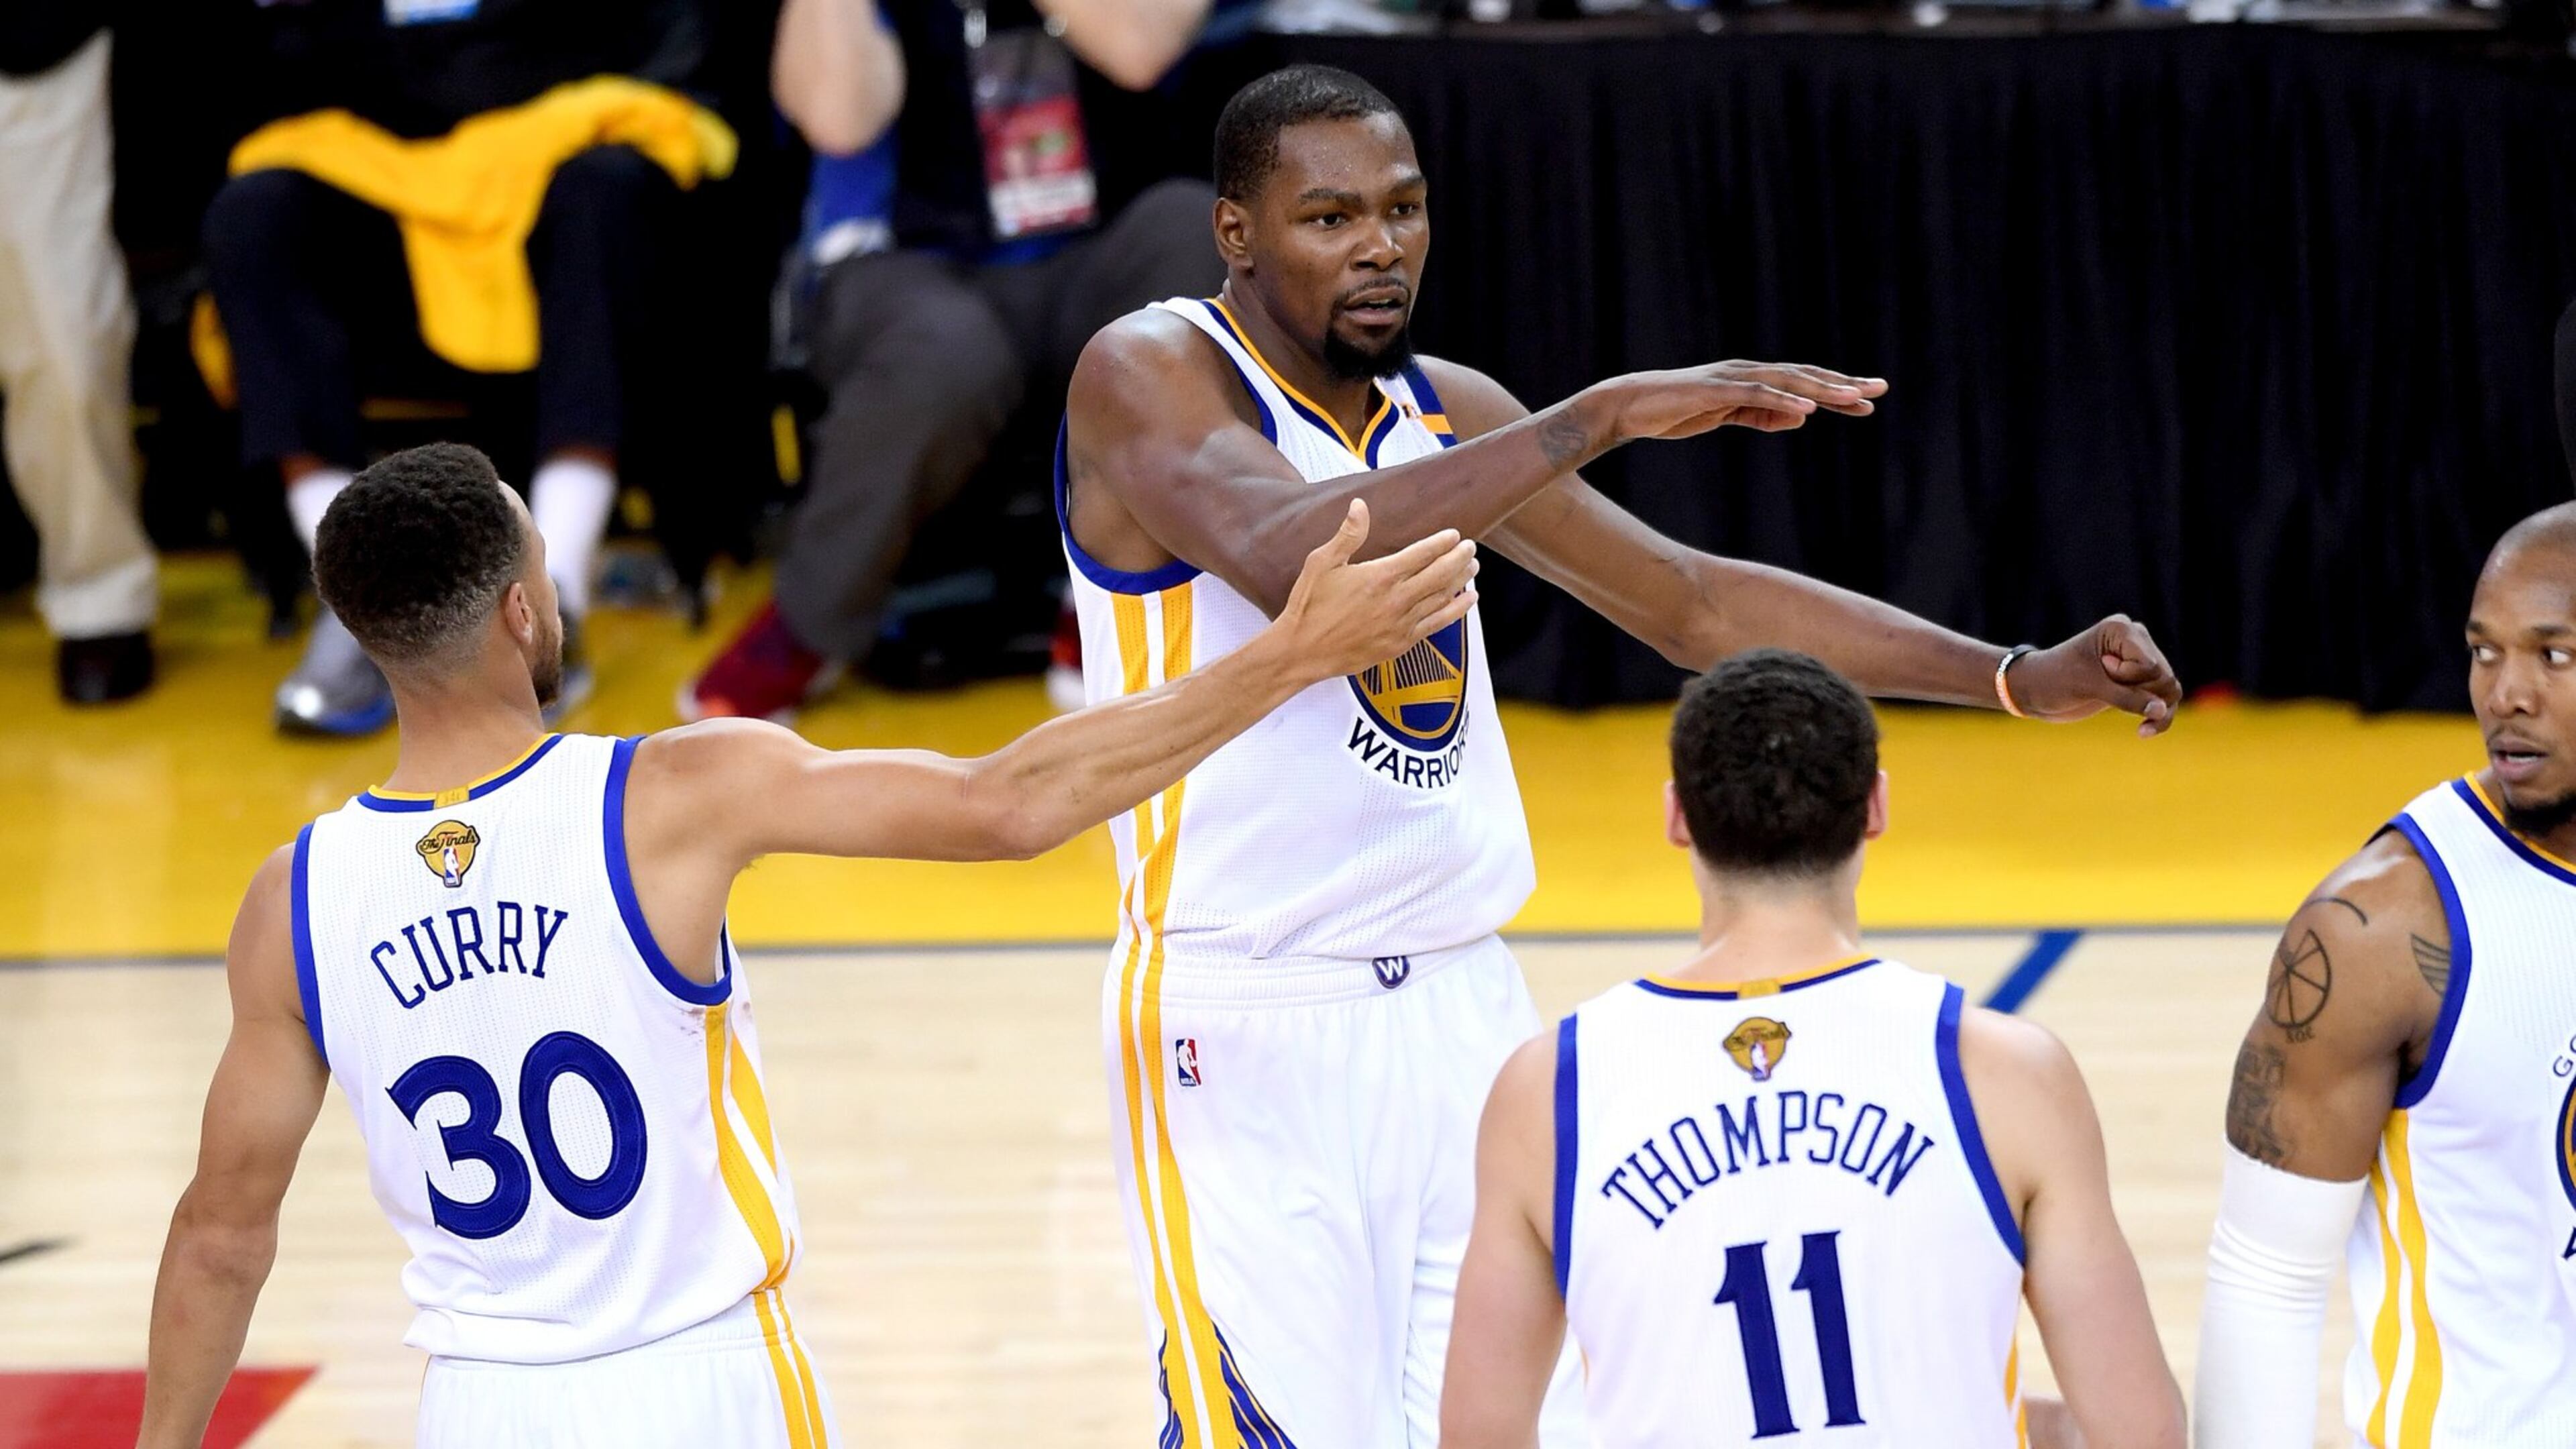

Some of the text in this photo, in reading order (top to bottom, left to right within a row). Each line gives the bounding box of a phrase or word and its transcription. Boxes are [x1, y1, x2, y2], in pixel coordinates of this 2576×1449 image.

[419, 829, 476, 852] The Finals
[370, 900, 568, 1010] CURRY
[1376, 956, 1403, 981] W
[384, 1030, 648, 1240] 30
[1601, 1091, 1935, 1230] THOMPSON
[1713, 1230, 1866, 1439] 11
